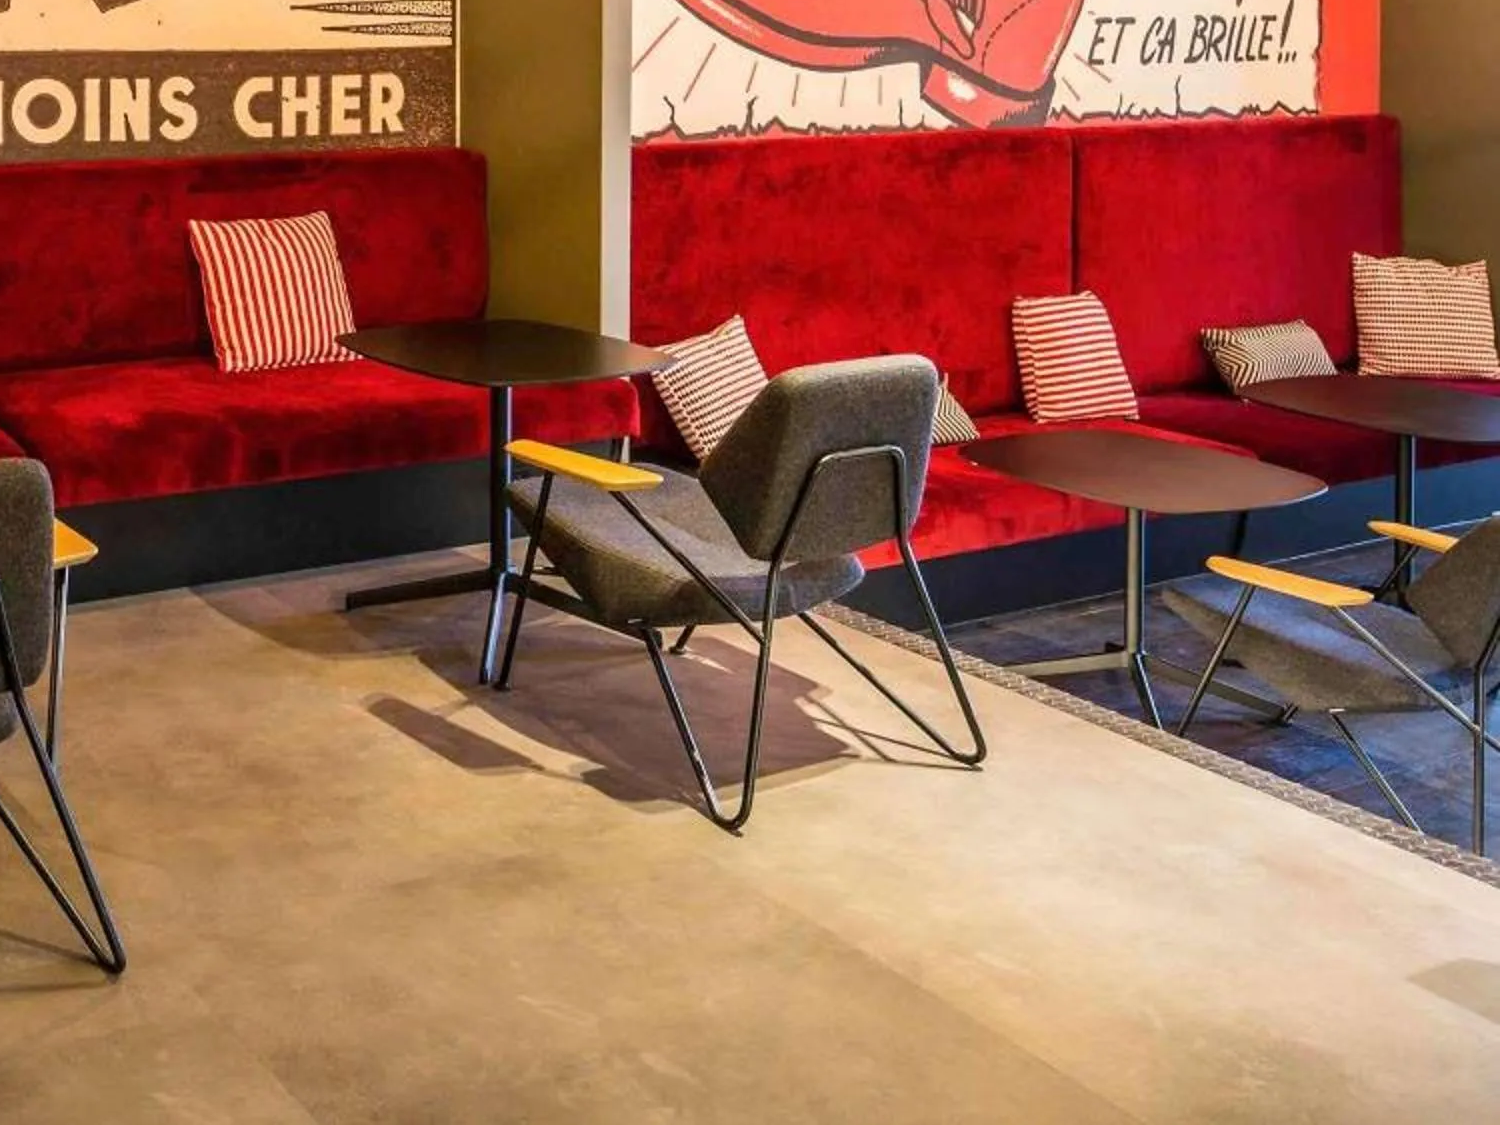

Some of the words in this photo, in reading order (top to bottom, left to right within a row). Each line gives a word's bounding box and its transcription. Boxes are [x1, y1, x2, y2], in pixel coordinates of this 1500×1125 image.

[1088, 16, 1137, 65] ET
[1139, 15, 1177, 65] CA
[233, 73, 406, 139] CHER
